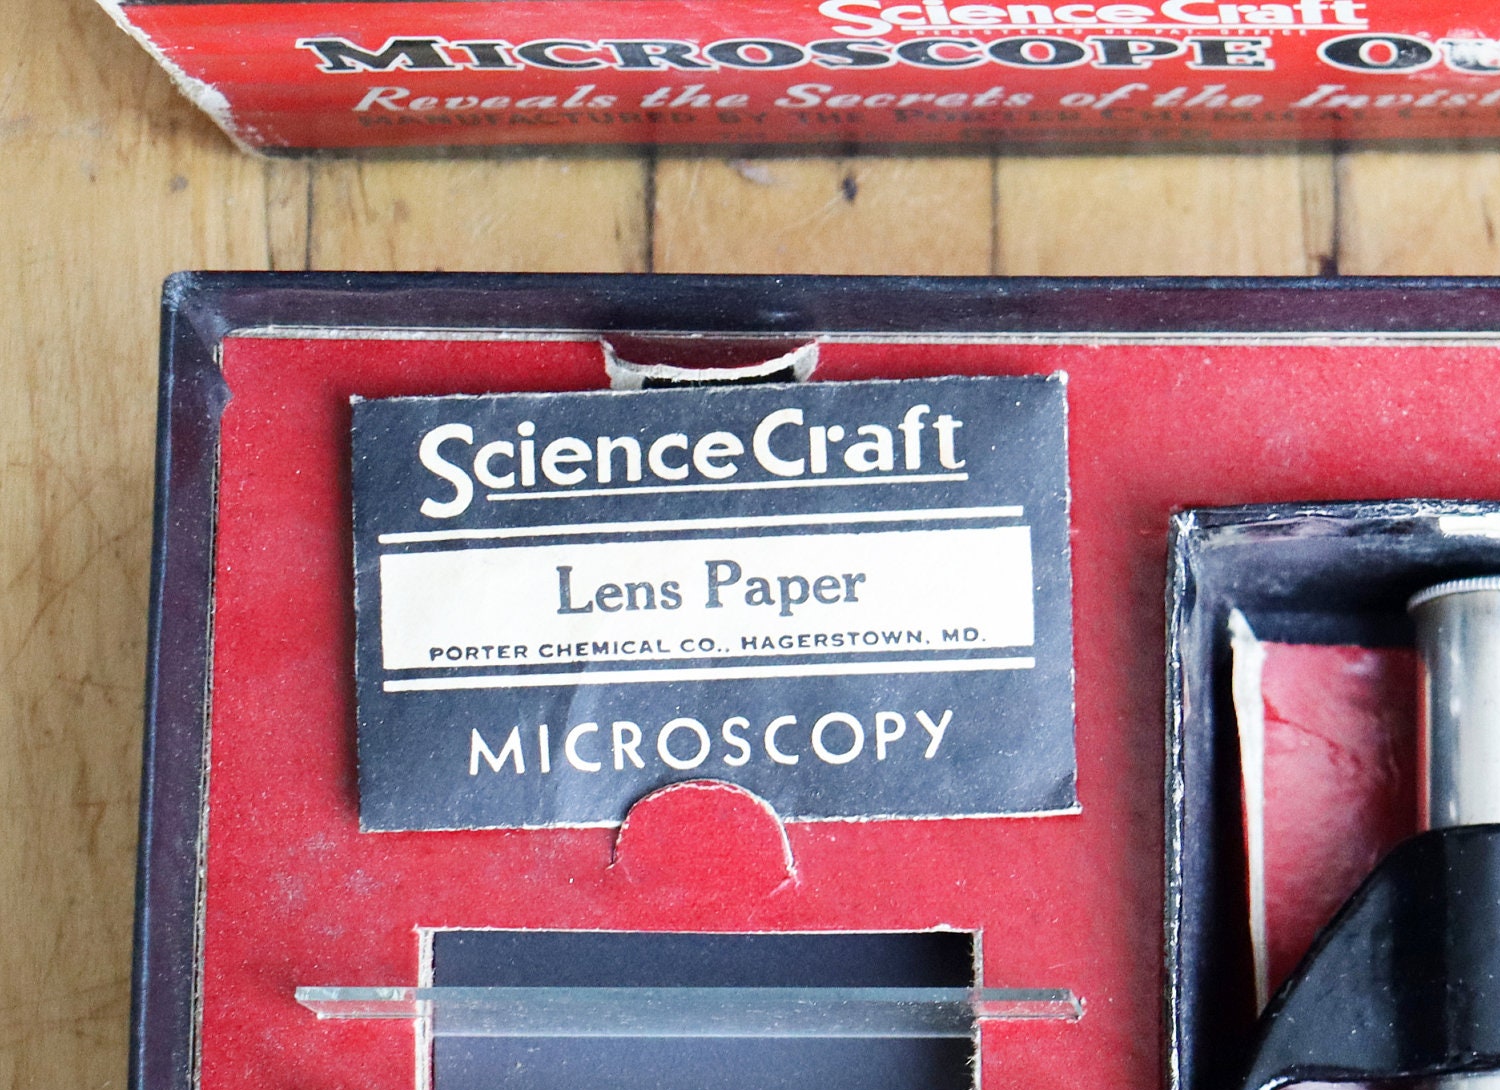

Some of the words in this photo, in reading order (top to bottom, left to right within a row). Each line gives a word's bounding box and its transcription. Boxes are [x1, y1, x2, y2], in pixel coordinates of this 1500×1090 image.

[297, 35, 1274, 73] MICROSCOPE
[352, 84, 618, 111] Reveals
[640, 84, 748, 108] the
[775, 83, 1032, 108] Secrets
[1060, 82, 1148, 109] of
[1152, 84, 1263, 108] the
[419, 404, 966, 518] ScienceCraft
[556, 564, 683, 615] Lens
[704, 558, 867, 617] Paper
[429, 645, 529, 662] PORTER
[538, 639, 671, 660] CHEMICAL
[942, 627, 986, 644] MD.
[468, 708, 953, 776] MICROSCOPY
